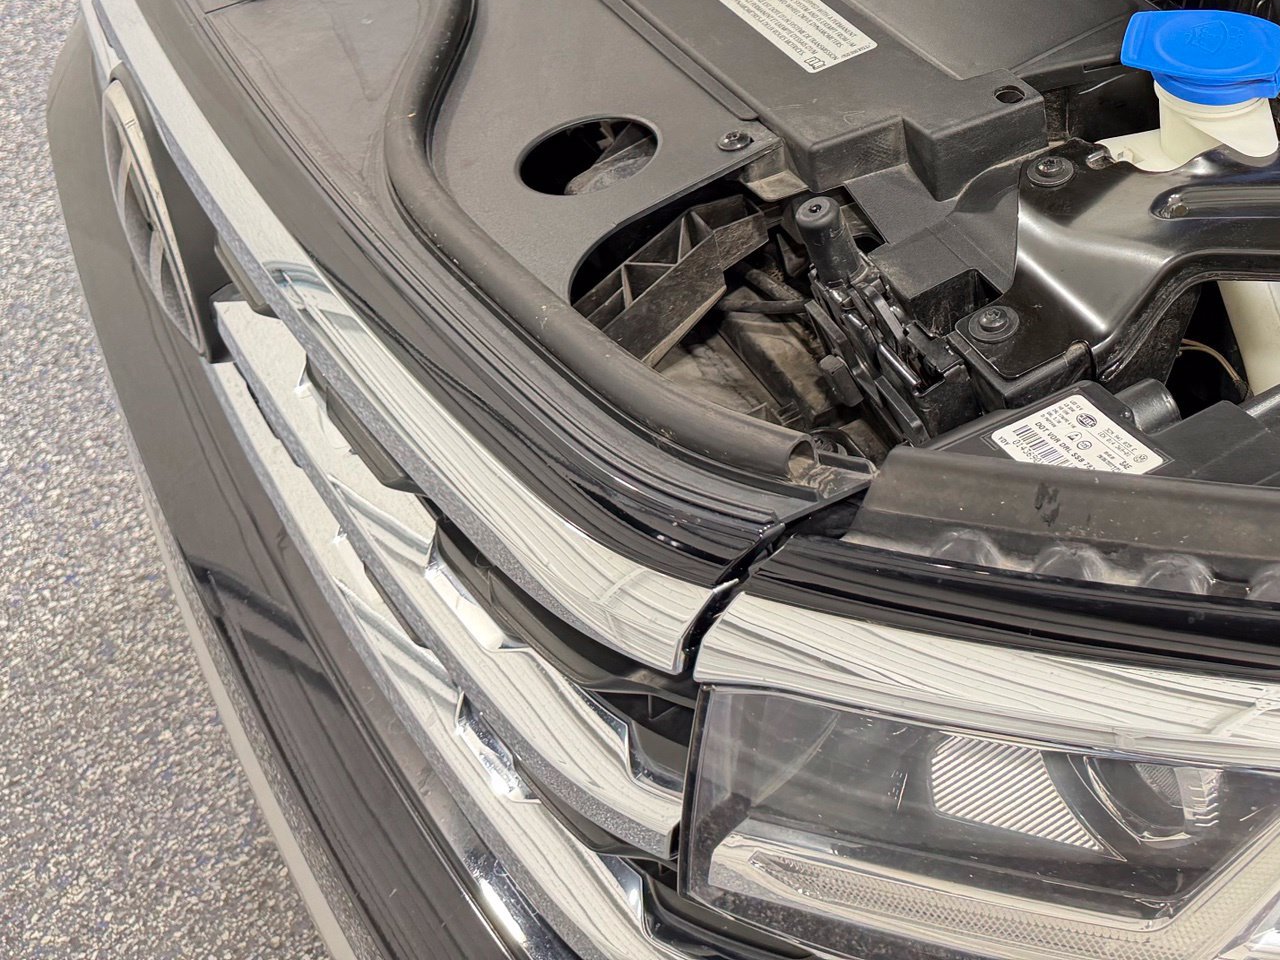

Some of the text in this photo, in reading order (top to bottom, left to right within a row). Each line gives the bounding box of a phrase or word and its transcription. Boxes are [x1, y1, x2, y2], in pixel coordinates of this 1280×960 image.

[829, 18, 858, 37] PERMANENT
[1034, 422, 1048, 431] DOT
[1058, 442, 1073, 452] DRL
[1118, 460, 1133, 469] SAE
